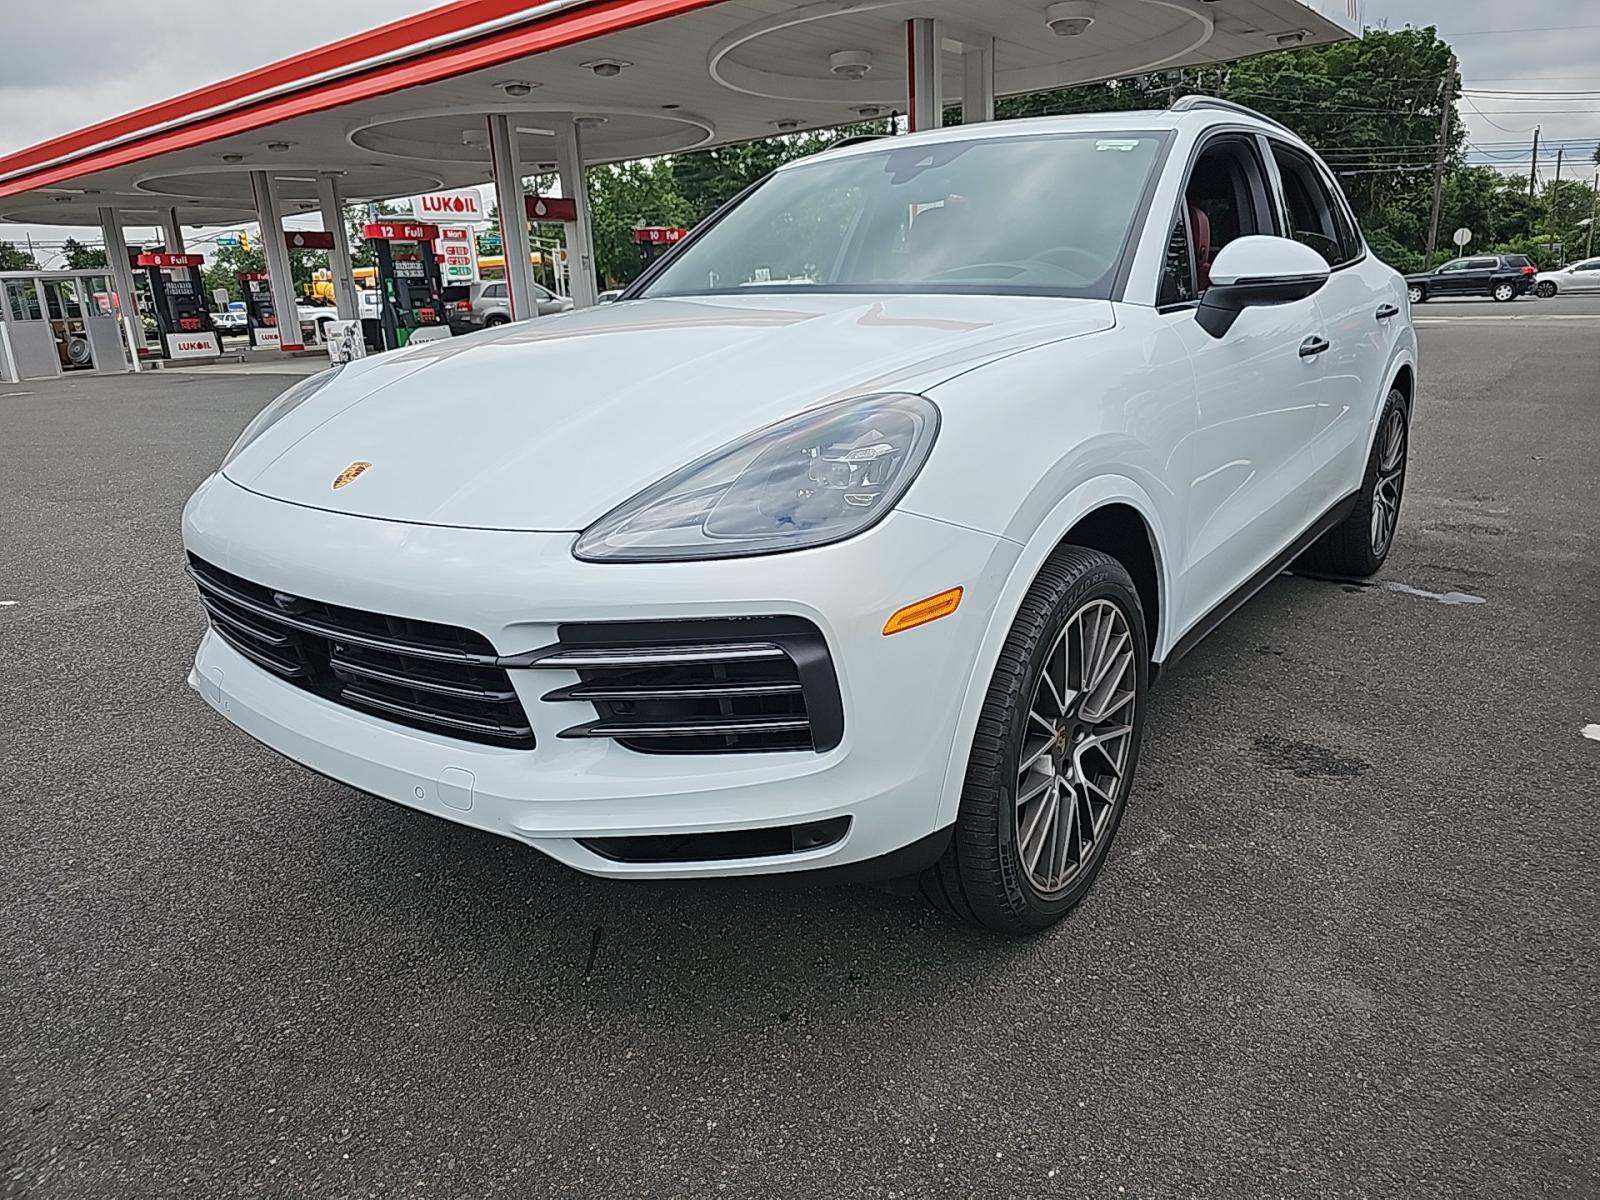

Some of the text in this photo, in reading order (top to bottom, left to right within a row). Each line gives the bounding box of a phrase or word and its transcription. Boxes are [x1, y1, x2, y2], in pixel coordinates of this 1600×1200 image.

[422, 195, 477, 212] LUKOIL
[381, 226, 423, 238] 12 Full
[650, 231, 678, 240] 10 Full
[170, 256, 187, 264] Full
[178, 341, 212, 351] LUKOIL
